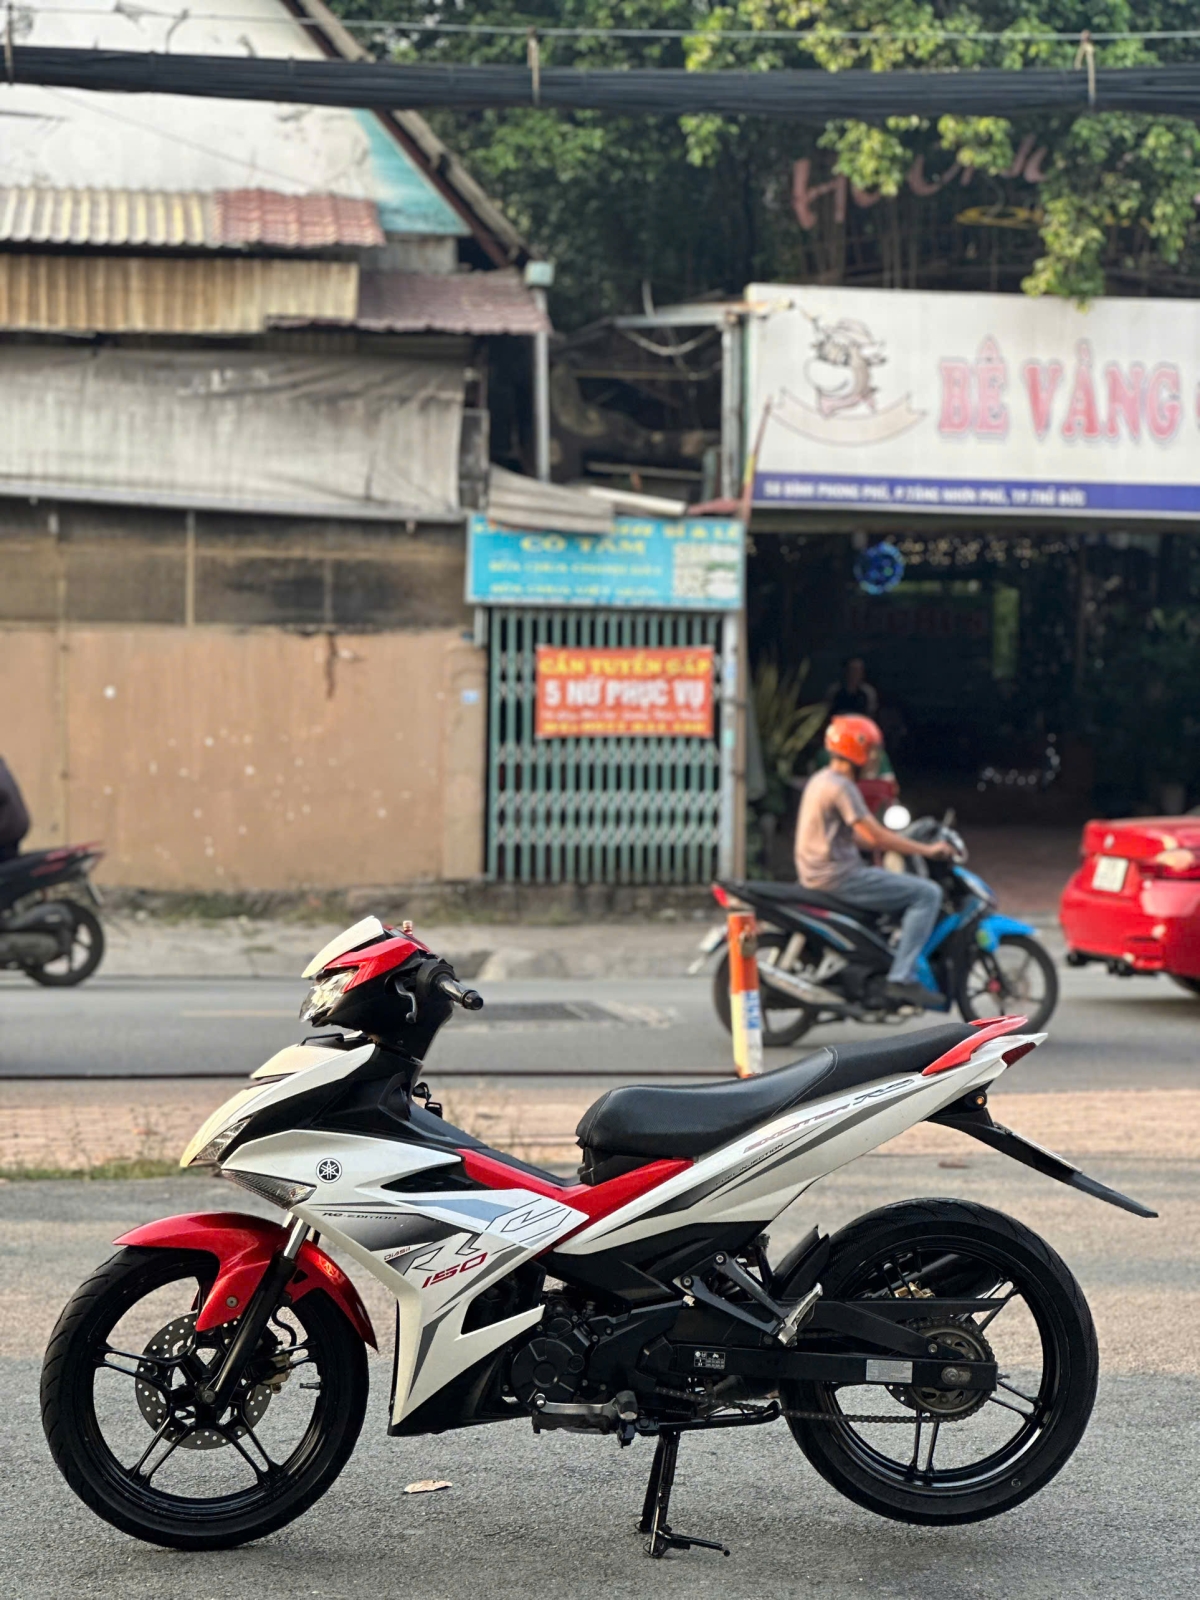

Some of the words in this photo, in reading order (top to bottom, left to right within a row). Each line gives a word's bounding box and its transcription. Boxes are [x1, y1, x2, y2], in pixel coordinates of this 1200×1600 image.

[938, 334, 1009, 440] BÊ
[545, 680, 561, 706] 5
[422, 1251, 489, 1290] 150
